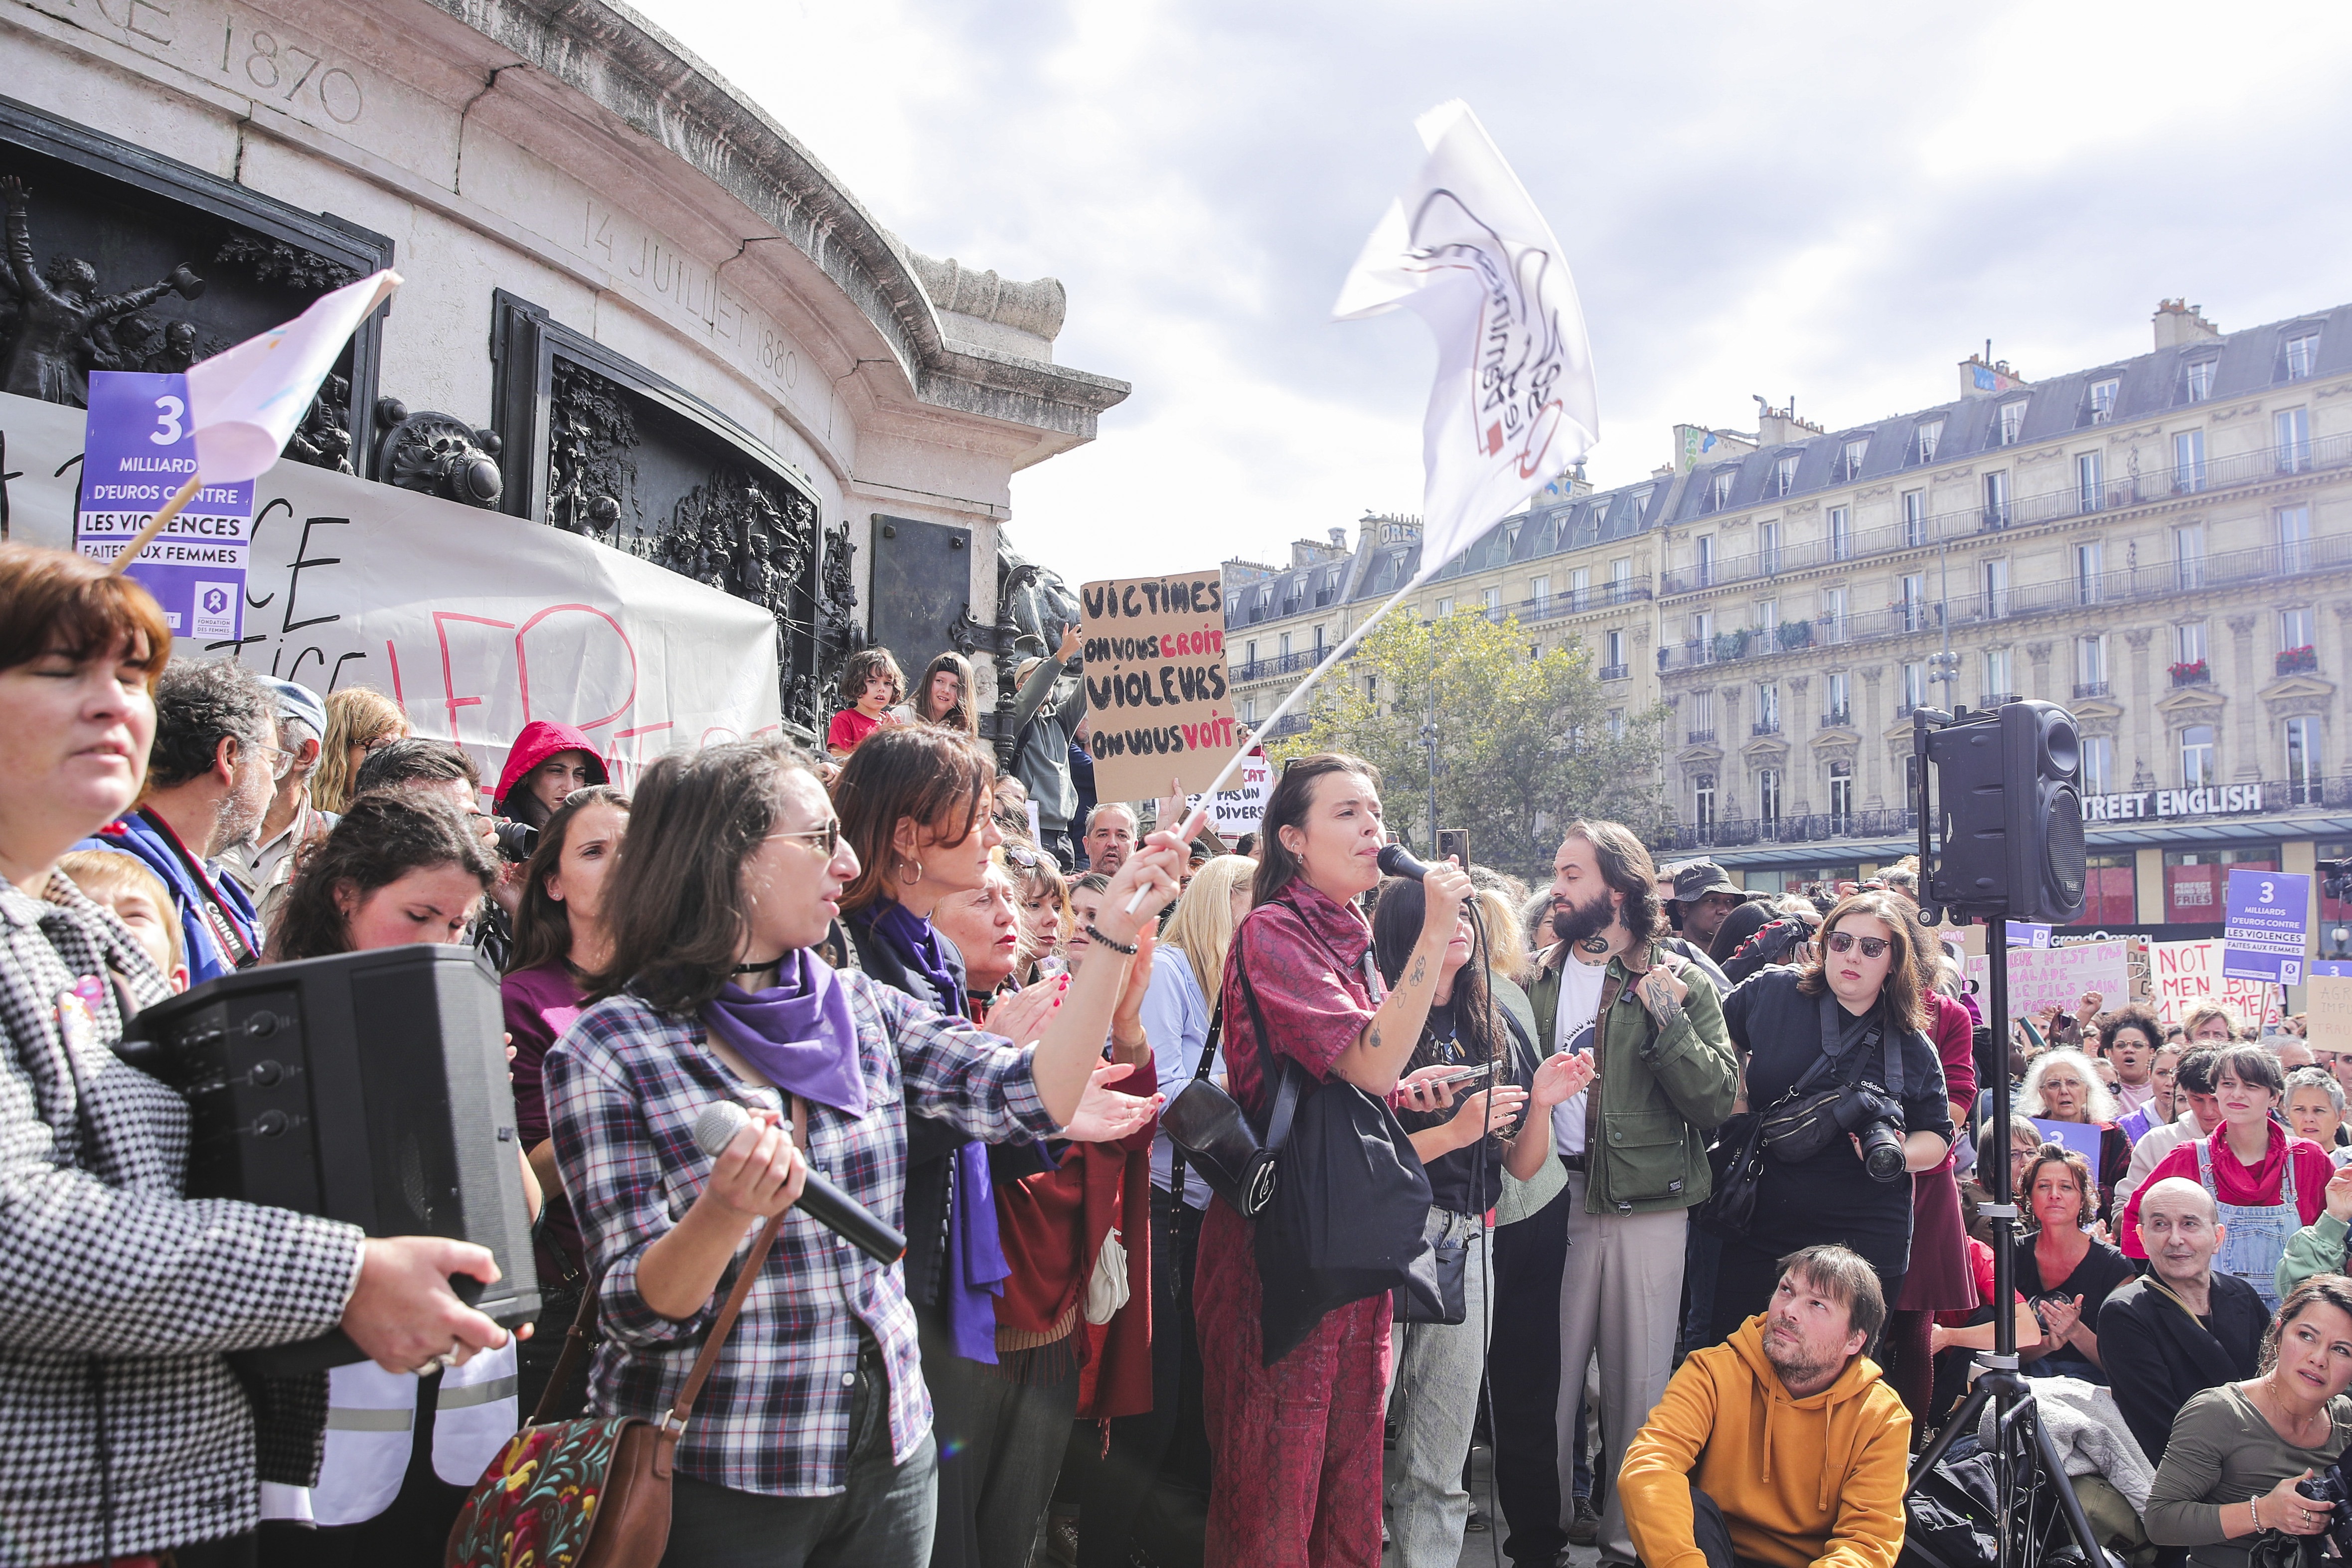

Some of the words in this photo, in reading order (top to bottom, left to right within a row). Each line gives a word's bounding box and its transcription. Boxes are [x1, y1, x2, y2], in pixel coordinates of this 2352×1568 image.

[221, 13, 363, 124] 1870
[583, 201, 613, 262] 14
[628, 237, 750, 348] JUILLET
[756, 321, 798, 389] 1880
[150, 395, 185, 446] 3
[119, 457, 200, 473] MILLIARD
[95, 485, 160, 499] D'EUROS
[163, 486, 239, 504] CNTRE
[86, 514, 115, 531] LES
[120, 514, 240, 536] VIOENCES
[135, 546, 161, 559] UX
[166, 547, 237, 563] FEMMES
[1111, 635, 1159, 662] VOUS
[1125, 725, 1184, 756] VOUS
[1243, 787, 1259, 800] UN
[2081, 791, 2149, 821] TREET
[2157, 784, 2262, 816] ENGLISH
[2177, 896, 2210, 904] FRIES
[2258, 881, 2274, 903] 3
[2244, 907, 2286, 916] MILLIARDS
[204, 901, 241, 950] Canon
[2266, 919, 2300, 929] CONTRE
[2228, 929, 2243, 937] LES
[2246, 930, 2302, 942] VIOLENCES
[1970, 958, 1984, 971] LE
[2007, 952, 2033, 968] LEUR
[2044, 947, 2089, 965] N'EST
[2097, 945, 2122, 961] PAS
[2159, 944, 2211, 974] NOT
[2008, 967, 2067, 985] MALADE
[2330, 965, 2340, 977] 3
[2015, 984, 2030, 998] LE
[2163, 976, 2210, 996] MEN
[2160, 1000, 2178, 1024] 1
[1563, 1021, 1583, 1040] HELLO
[1585, 1015, 1597, 1025] SU
[1861, 1081, 1885, 1094] adidas
